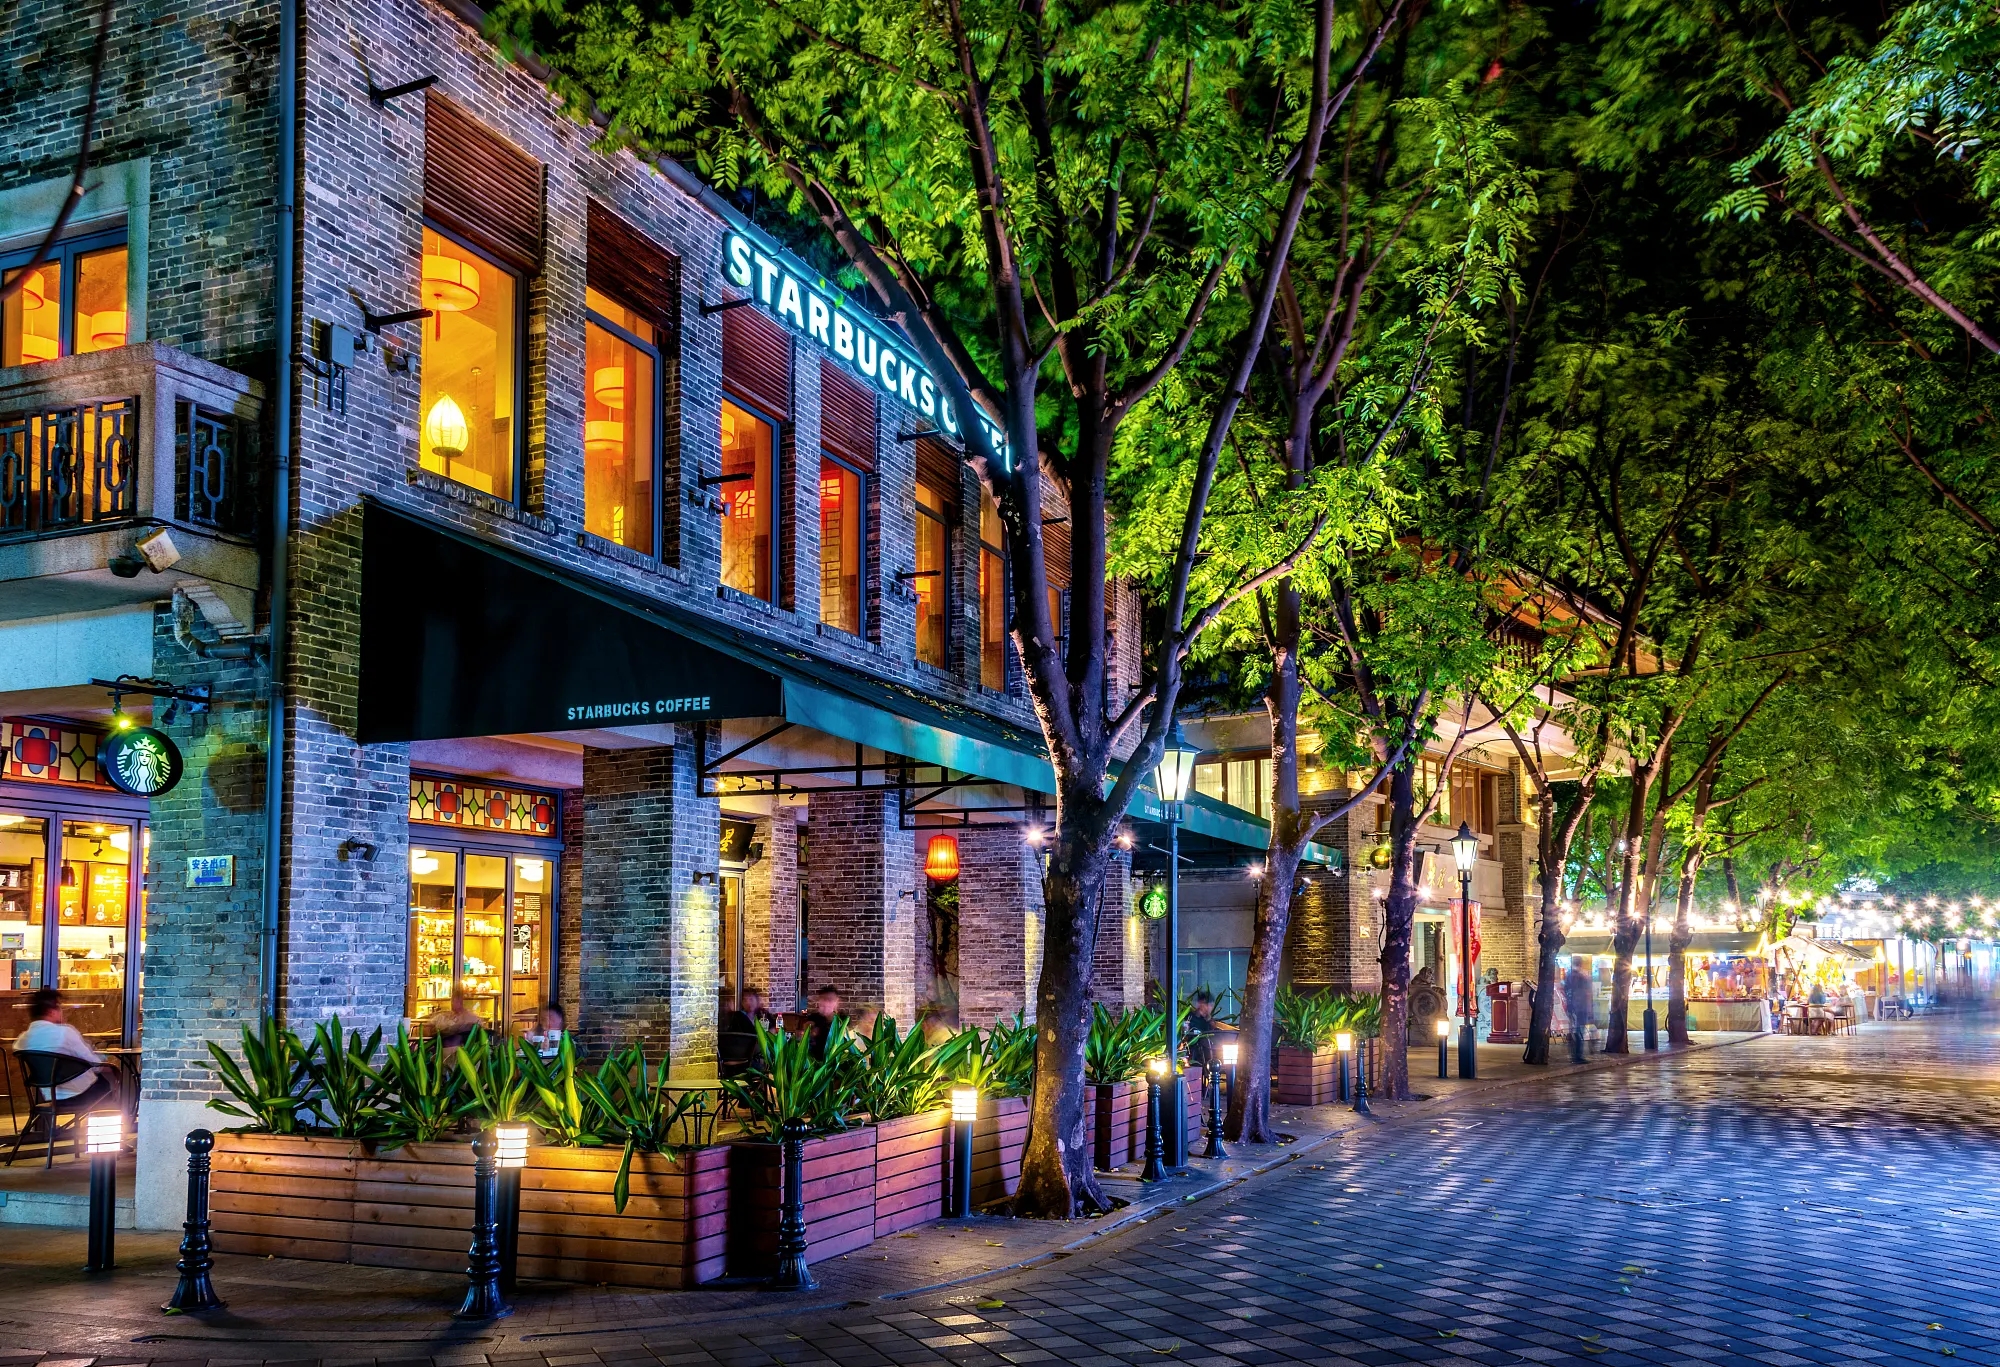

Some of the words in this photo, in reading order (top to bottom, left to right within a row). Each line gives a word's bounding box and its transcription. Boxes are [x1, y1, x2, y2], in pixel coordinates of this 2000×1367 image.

[729, 235, 934, 416] STARBUCKS
[568, 702, 649, 720] STARBUCKS
[655, 697, 710, 713] COFFEE
[192, 858, 227, 869] 安全出口
